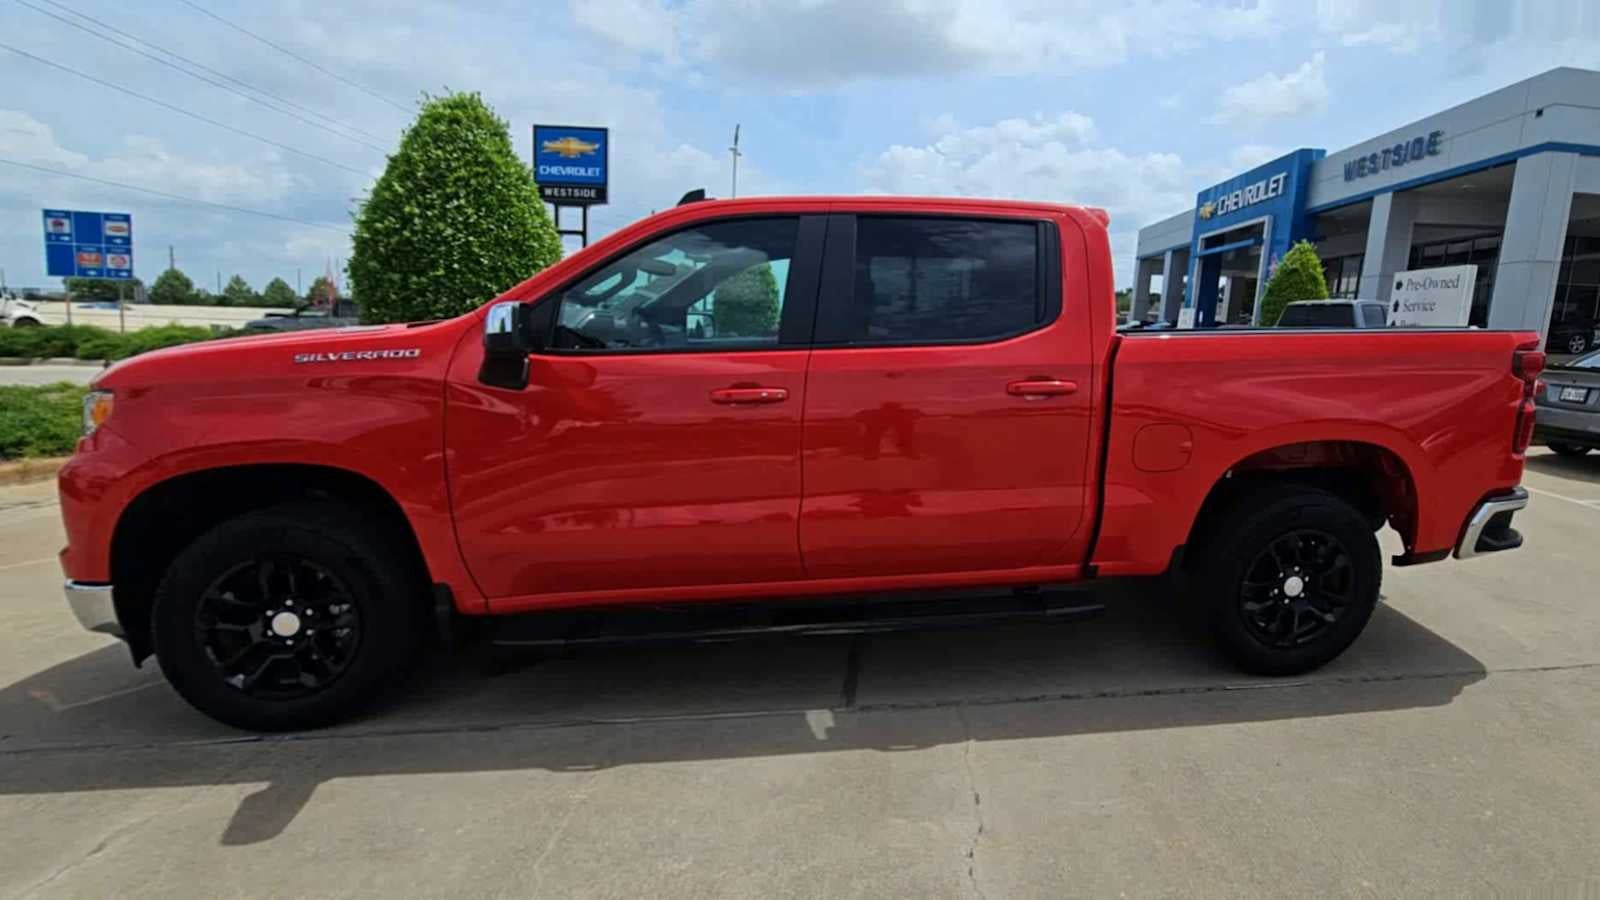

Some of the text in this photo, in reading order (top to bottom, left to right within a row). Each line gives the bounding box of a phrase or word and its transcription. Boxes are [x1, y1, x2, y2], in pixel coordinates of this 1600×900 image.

[1344, 130, 1444, 182] WESTSIDE
[539, 165, 601, 176] CHEVROLET
[544, 187, 597, 198] WESTSIDE
[1217, 172, 1288, 215] CHEVROLET
[1406, 275, 1459, 291] Pre-Owned
[294, 348, 421, 363] SILVERADO
